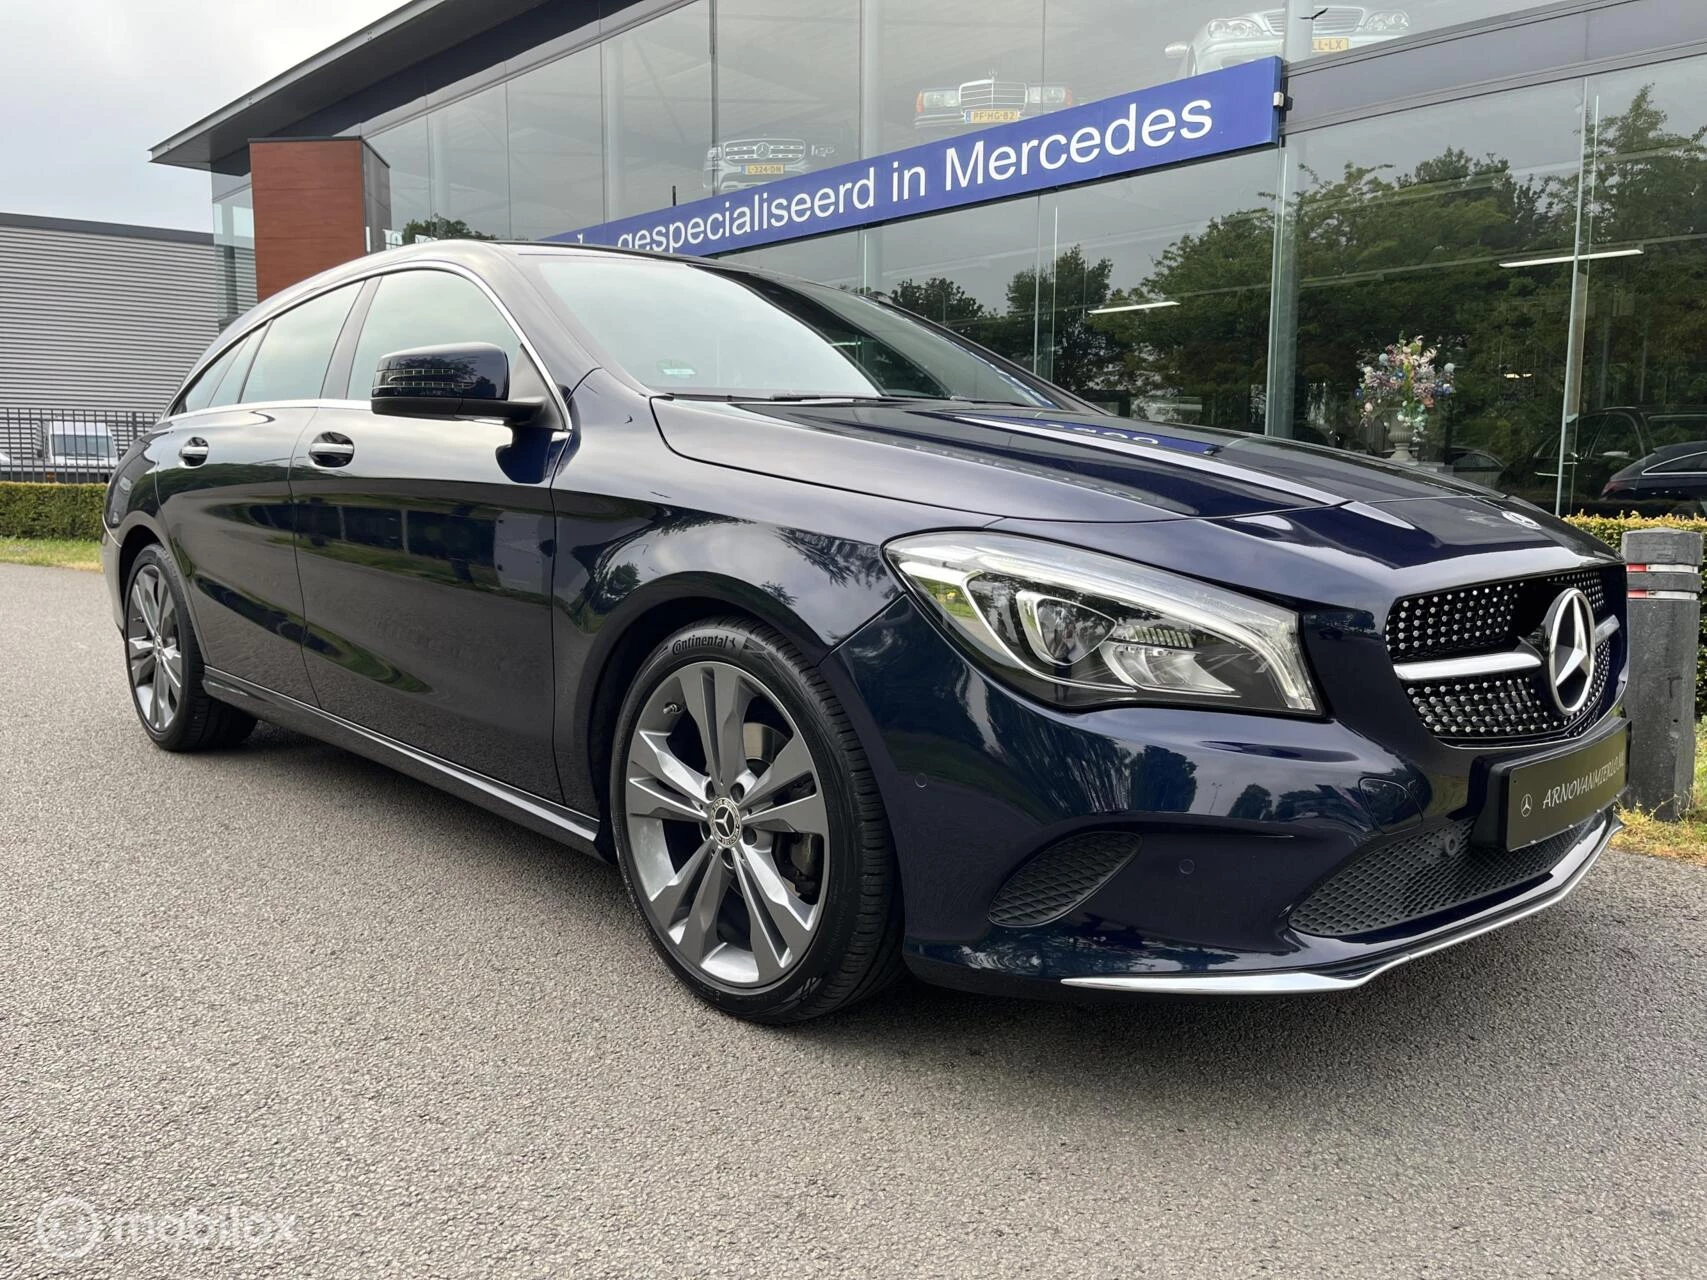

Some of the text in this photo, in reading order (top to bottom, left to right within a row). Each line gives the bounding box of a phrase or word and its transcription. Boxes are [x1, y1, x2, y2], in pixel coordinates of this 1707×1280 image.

[892, 161, 926, 202] in
[945, 99, 1213, 191] Mercedes
[672, 634, 729, 655] Continental
